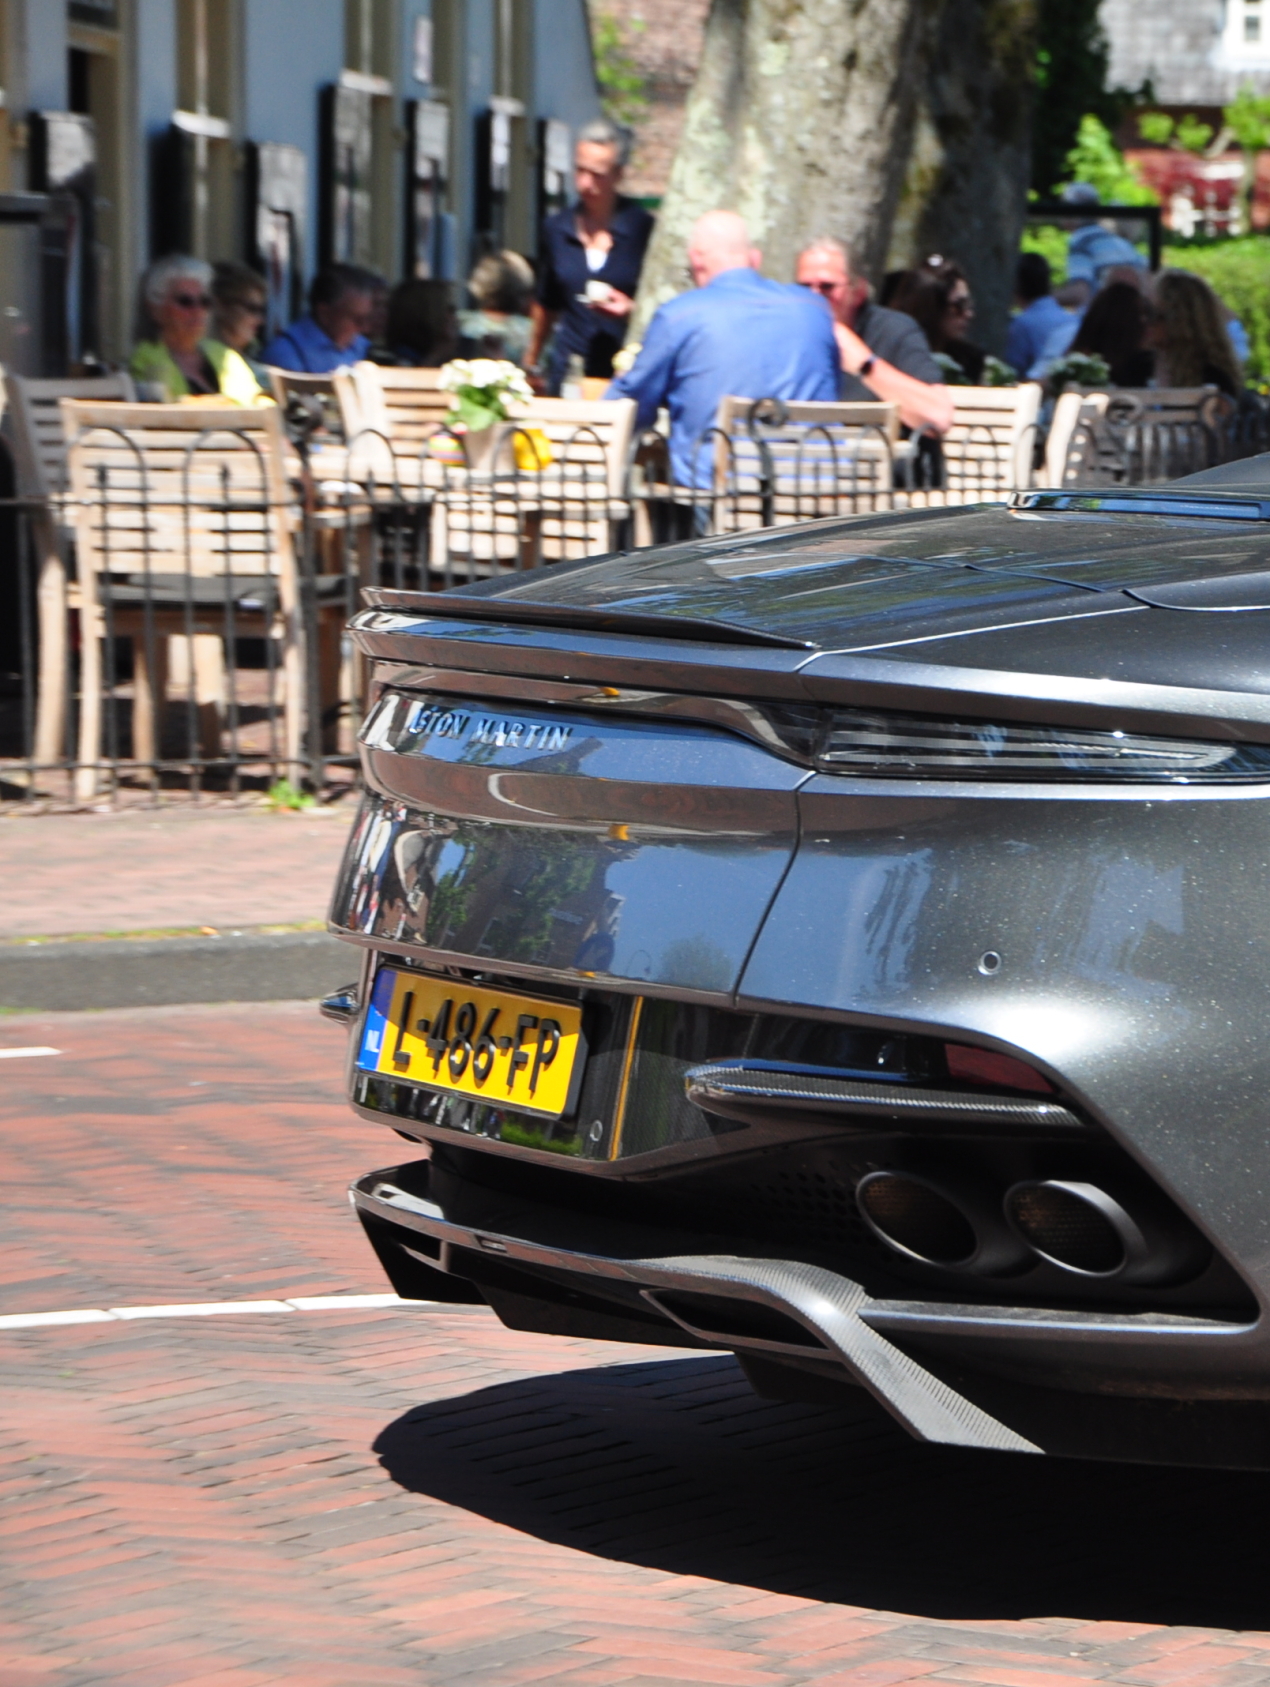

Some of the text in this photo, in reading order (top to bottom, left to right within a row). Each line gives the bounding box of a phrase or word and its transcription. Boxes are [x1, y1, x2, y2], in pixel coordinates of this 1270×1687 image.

[471, 718, 573, 751] MARTIN
[365, 1029, 380, 1053] NL
[392, 991, 561, 1093] L-486-FP
